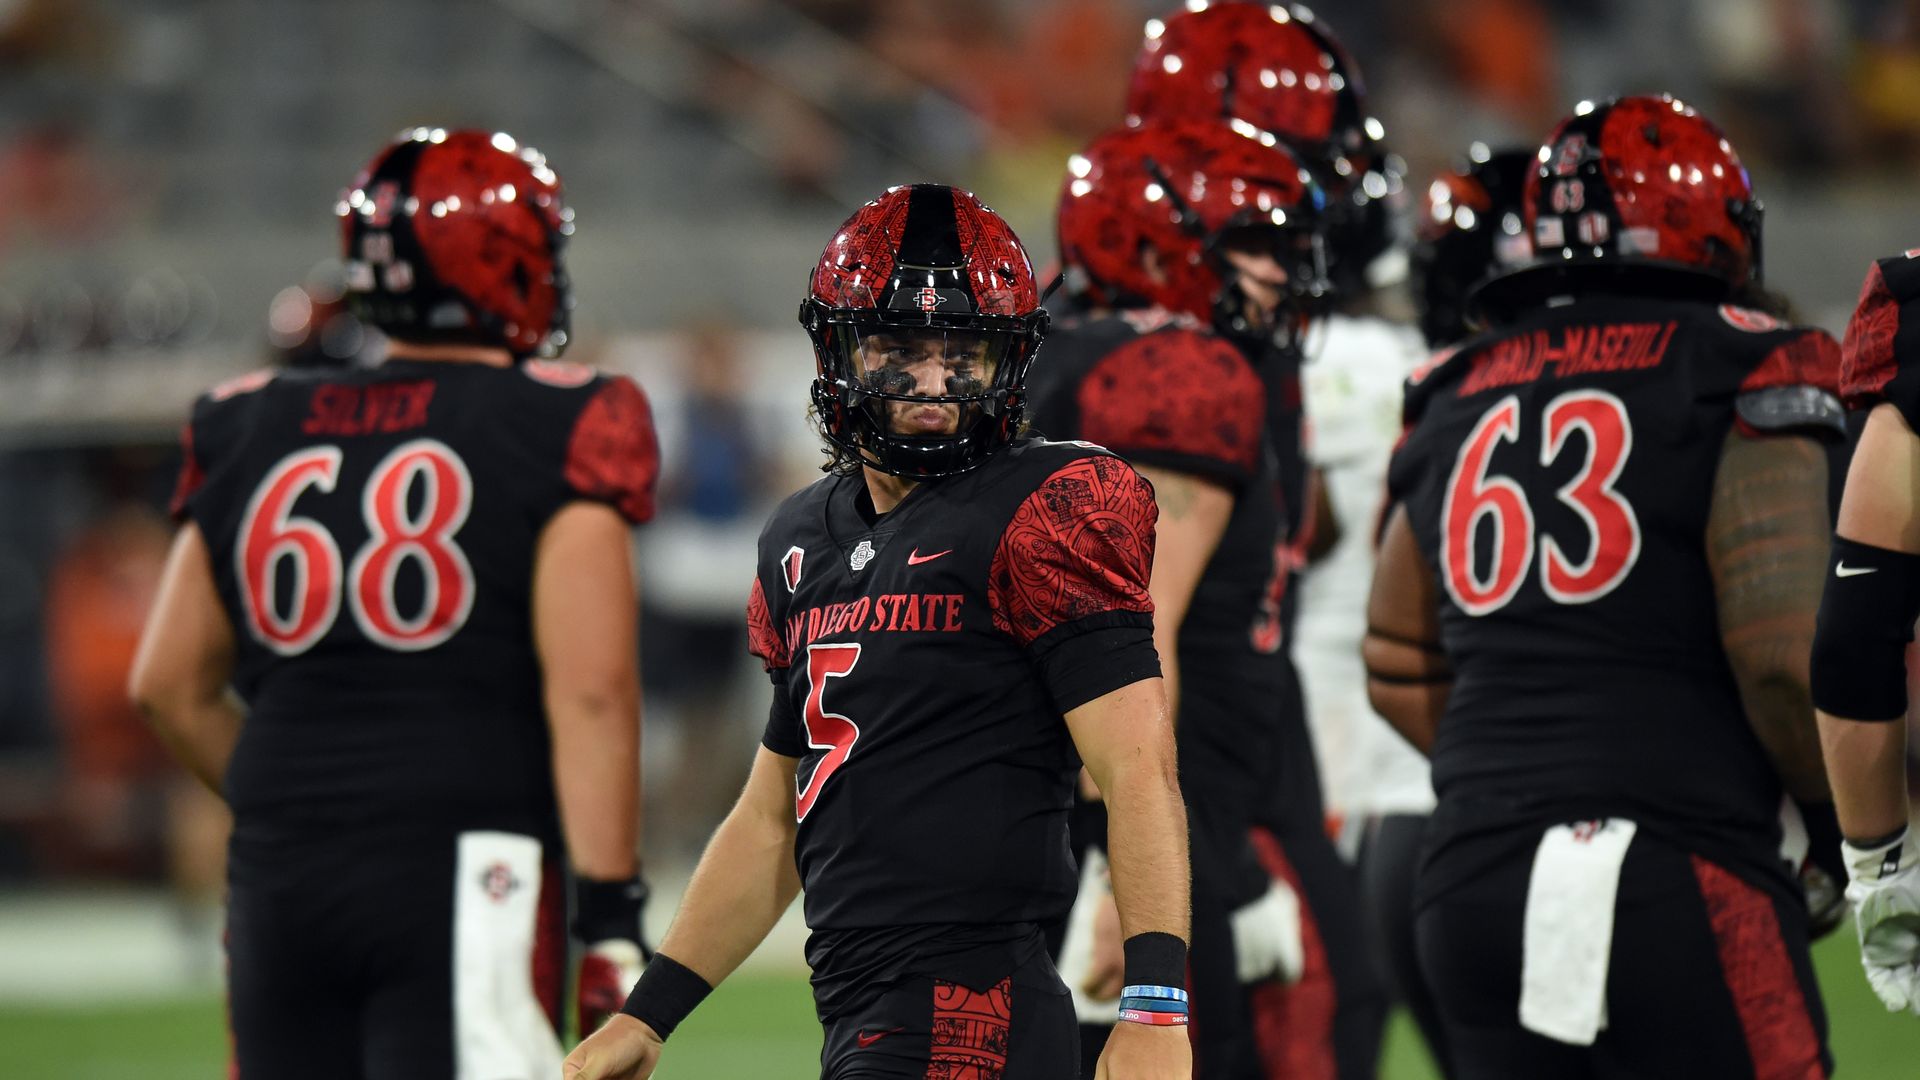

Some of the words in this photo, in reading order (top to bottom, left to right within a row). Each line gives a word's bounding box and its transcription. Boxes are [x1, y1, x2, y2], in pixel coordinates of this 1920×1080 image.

[235, 438, 476, 656] 68
[1440, 388, 1641, 616] 63
[807, 596, 871, 645] DIEGO
[869, 594, 964, 632] STATE
[796, 642, 861, 824] 5
[1125, 1012, 1140, 1020] OUT
